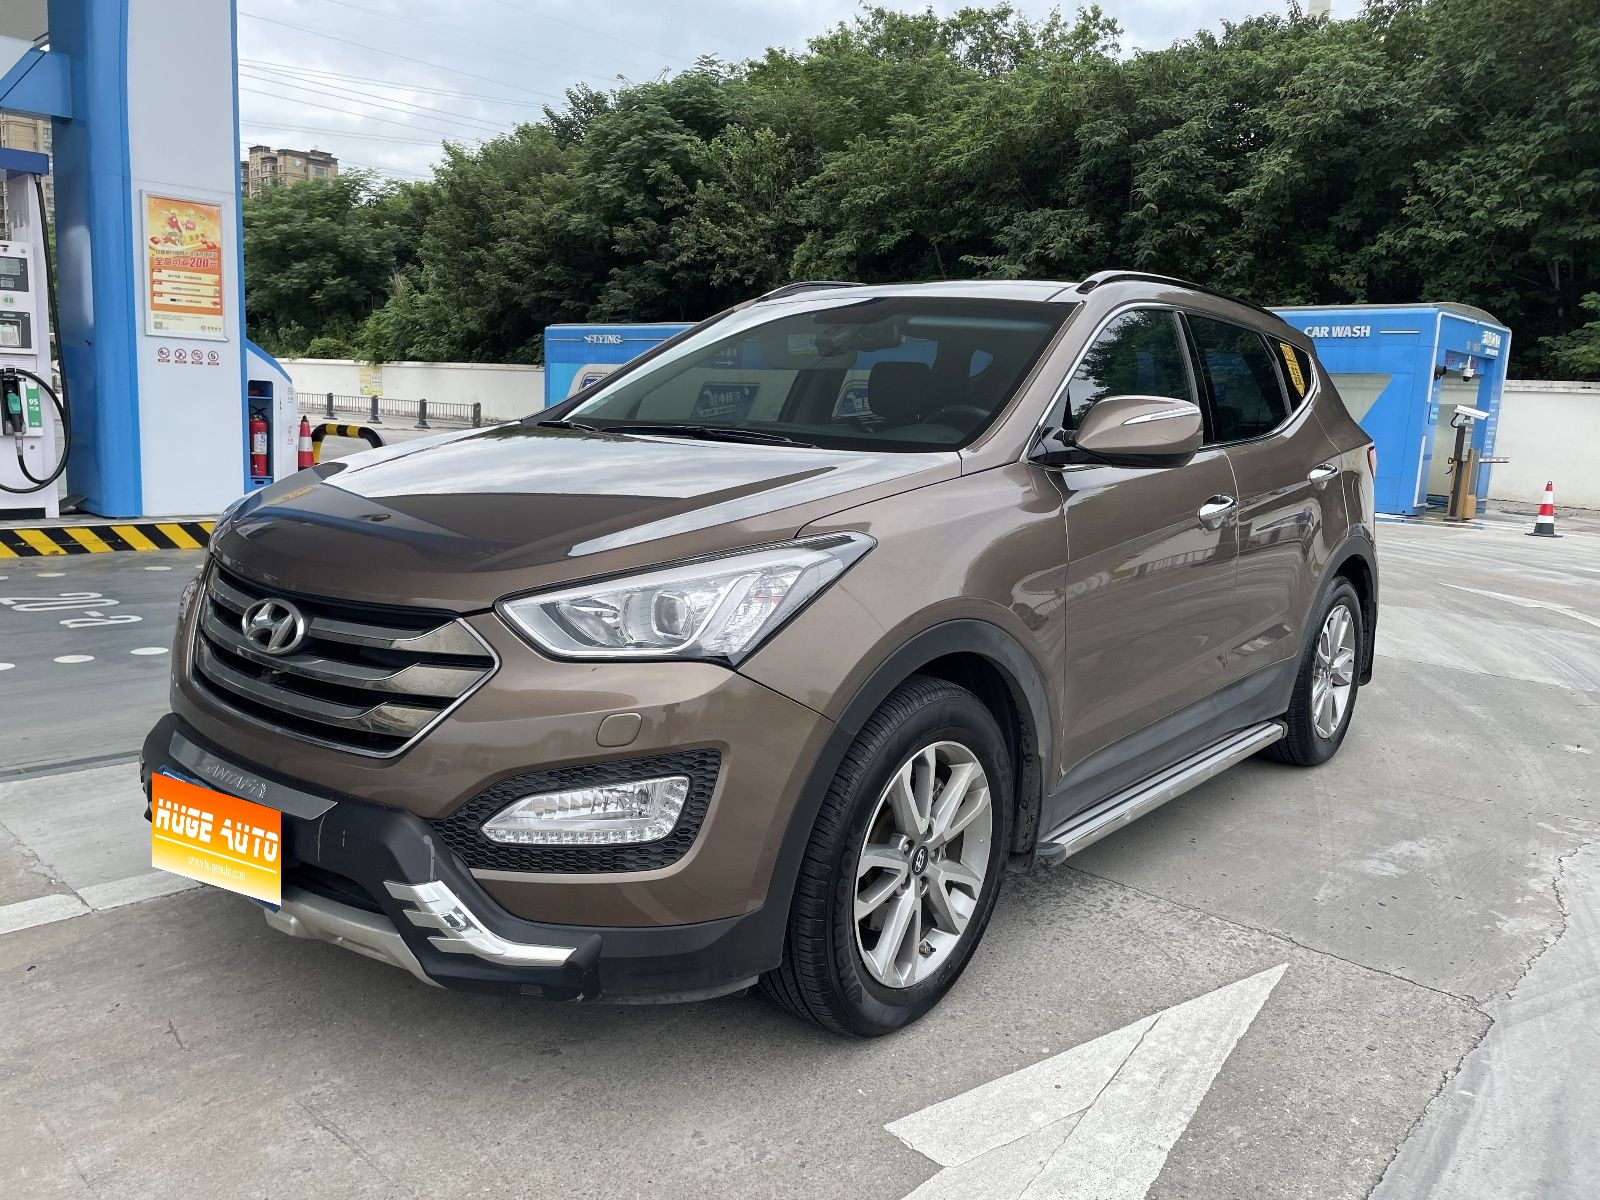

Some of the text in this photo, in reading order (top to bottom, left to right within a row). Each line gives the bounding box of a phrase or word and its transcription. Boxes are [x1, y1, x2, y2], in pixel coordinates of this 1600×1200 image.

[1303, 325, 1371, 338] CAR WASH
[586, 334, 622, 344] FLYING
[28, 398, 39, 406] 95
